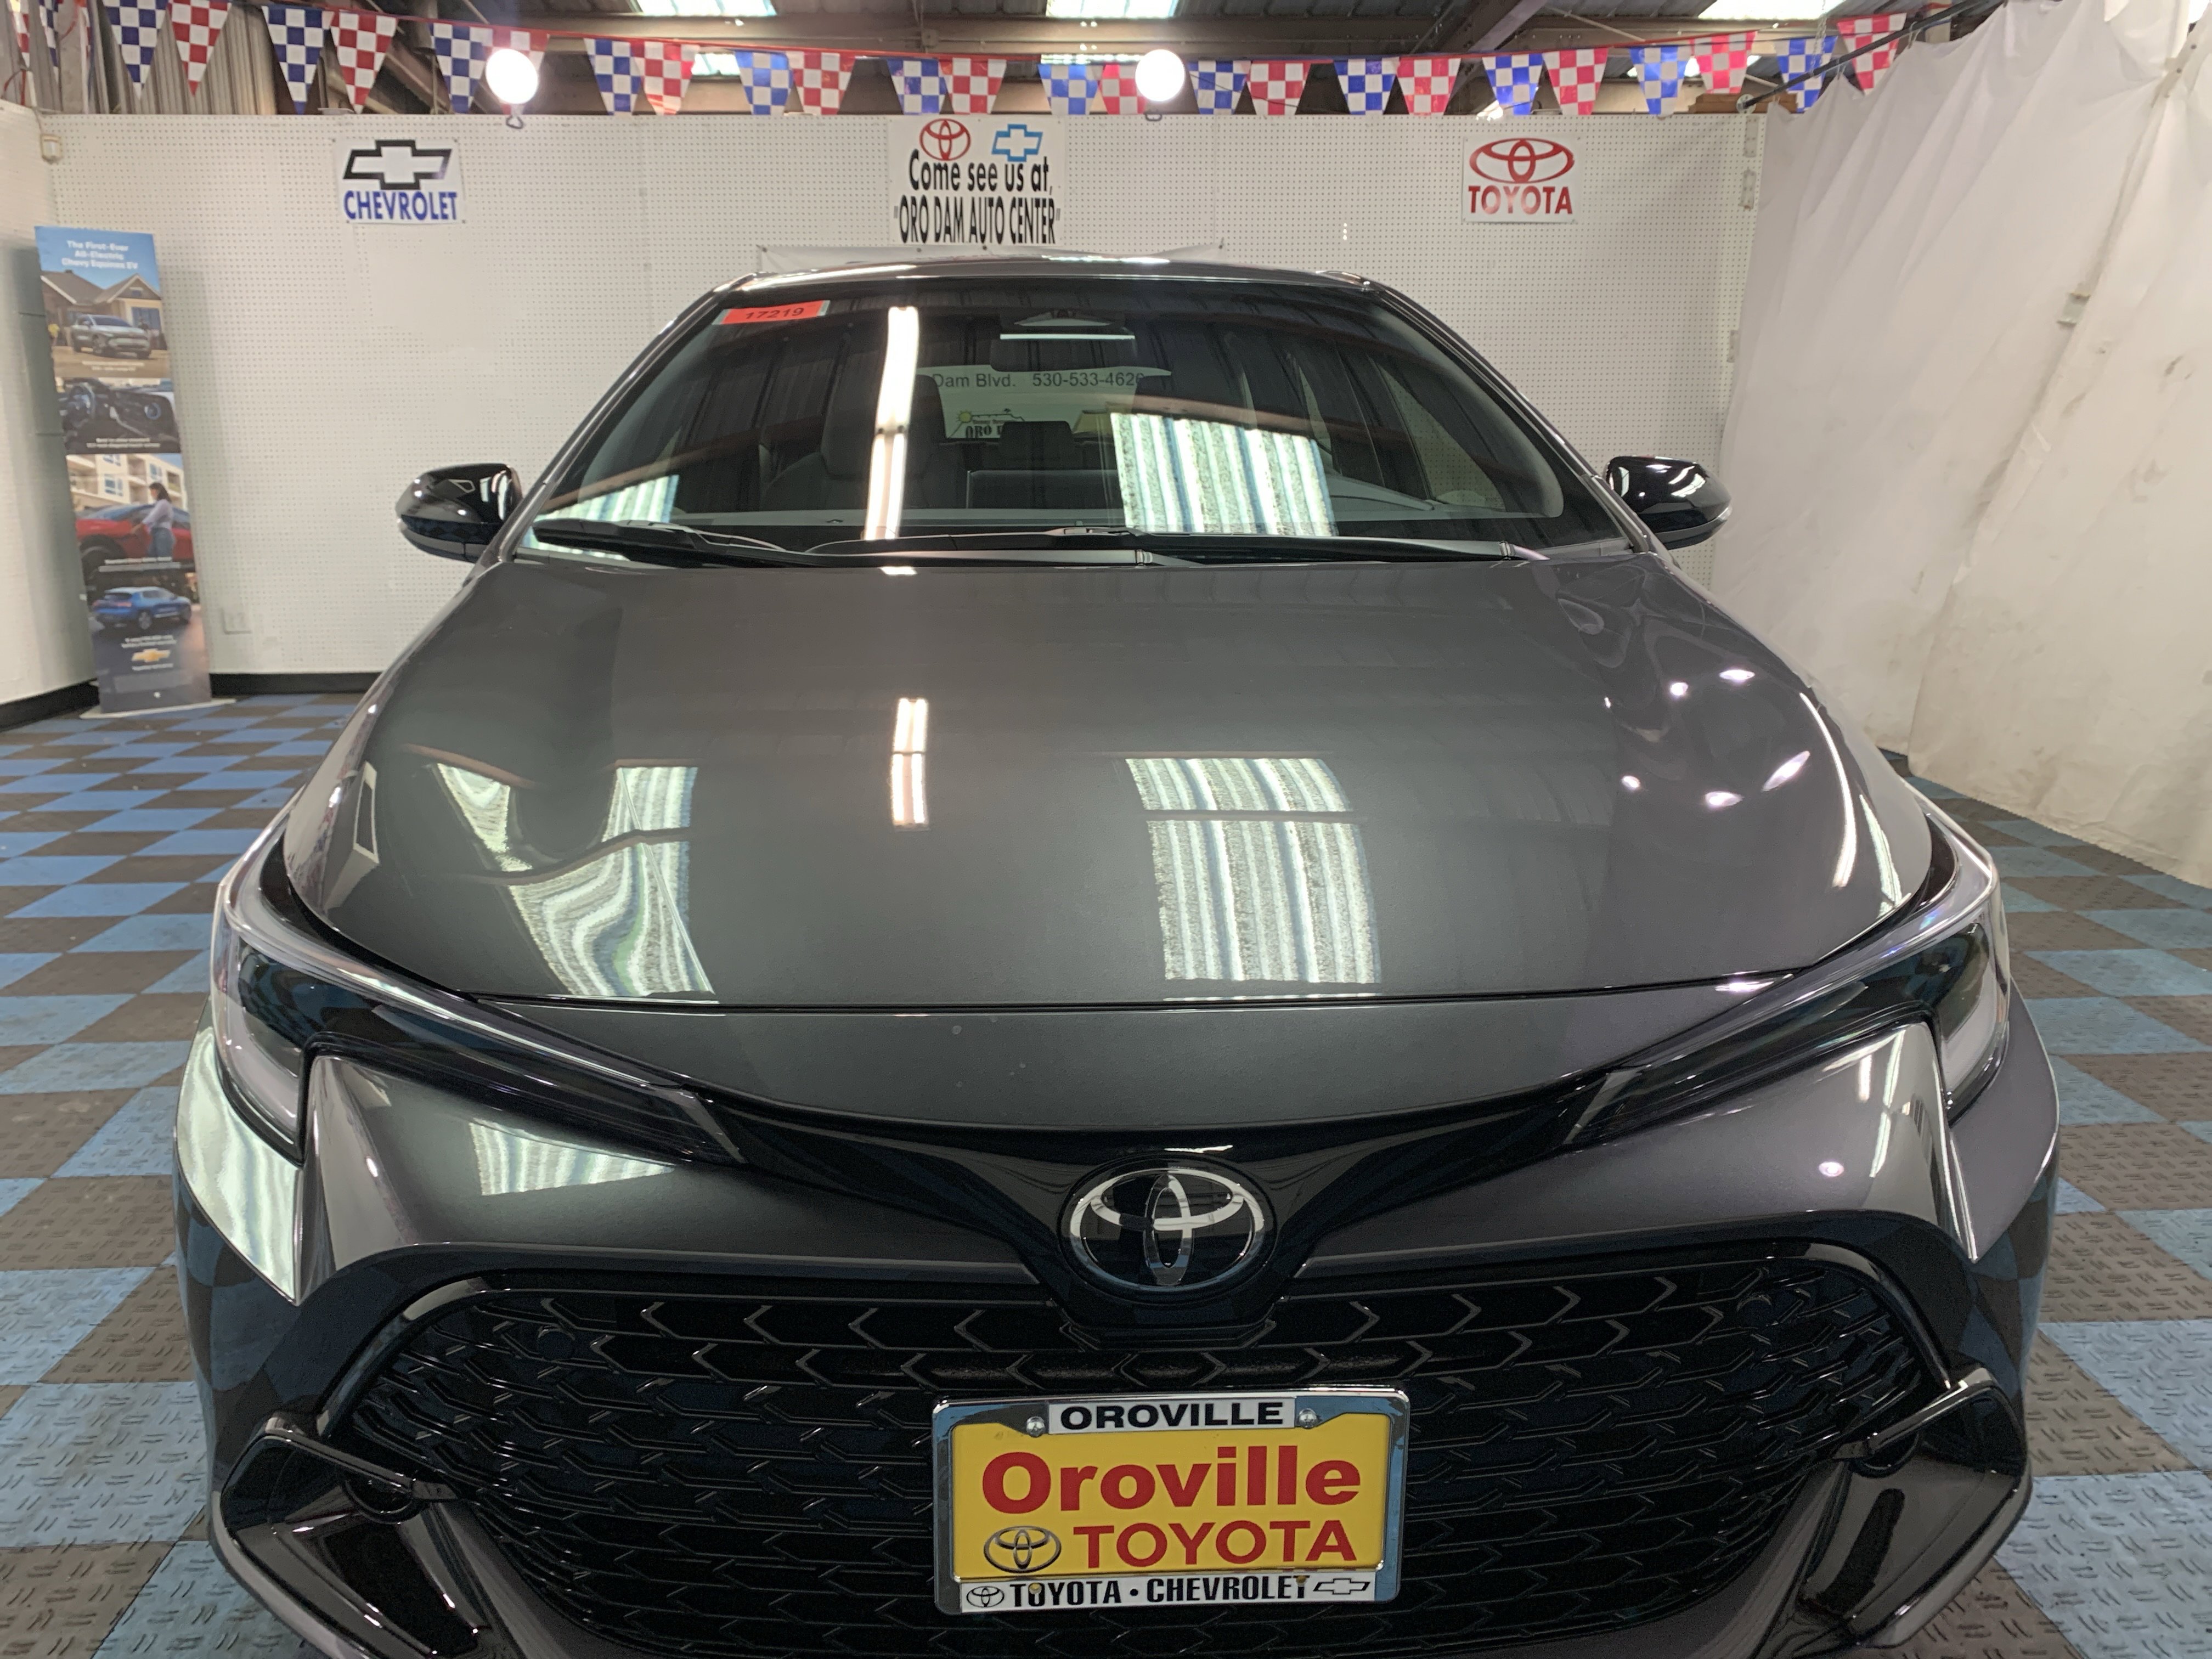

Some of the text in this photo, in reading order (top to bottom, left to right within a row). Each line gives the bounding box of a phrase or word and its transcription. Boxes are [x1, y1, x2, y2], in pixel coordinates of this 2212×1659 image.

[909, 149, 961, 190] Come
[968, 162, 997, 191] see
[1005, 163, 1024, 191] us
[343, 190, 457, 220] CHEVROLET
[1468, 185, 1573, 215] TOYOTA
[934, 196, 964, 243] DAM
[969, 196, 1005, 244] AUTO
[66, 240, 83, 249] The
[746, 307, 804, 319] 17219
[933, 374, 969, 387] Dam
[976, 374, 1015, 387] Blvd.
[966, 425, 992, 438] ORO
[1060, 1402, 1284, 1430] OROVILLE
[983, 1445, 1361, 1515] Oroville
[1074, 1520, 1357, 1568] TOYOTA
[1010, 1575, 1310, 1607] TOYOTA CHEVROLET
